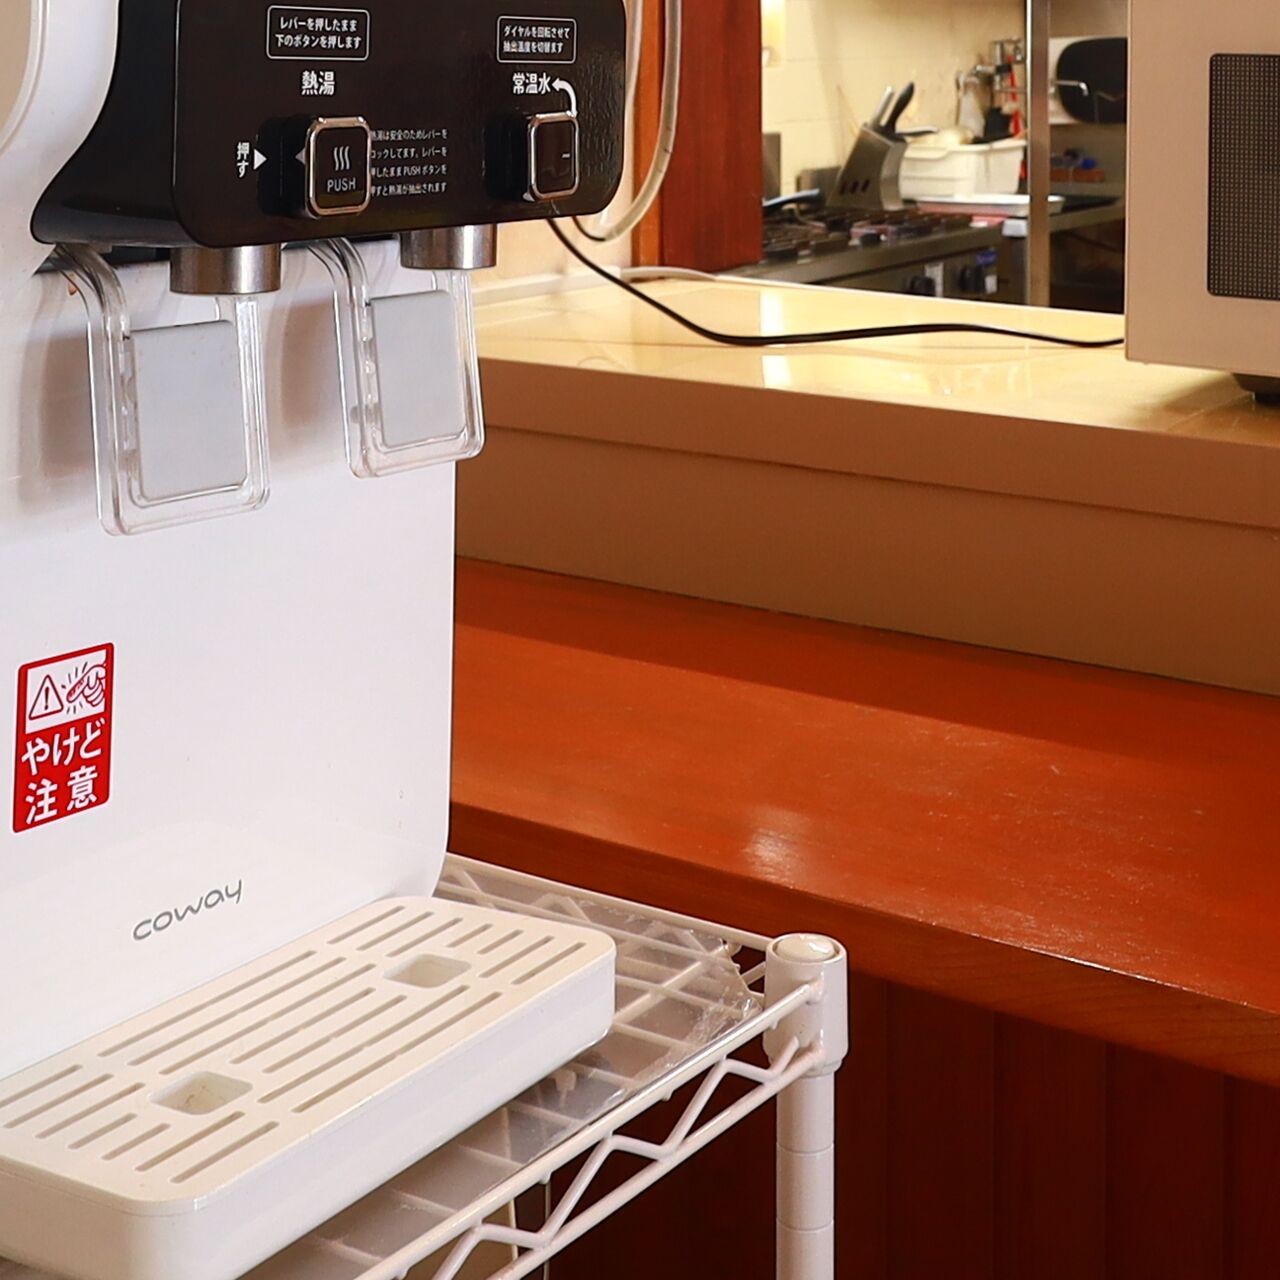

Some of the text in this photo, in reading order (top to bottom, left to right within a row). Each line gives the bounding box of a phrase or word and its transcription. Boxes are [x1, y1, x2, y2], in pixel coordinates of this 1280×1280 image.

[280, 16, 358, 33] レバーを押したまま
[503, 24, 570, 40] ダイヤルを回転させて
[275, 33, 362, 50] 下のボタンを押します
[301, 70, 336, 96] 熱湯
[512, 72, 551, 95] 常温水
[236, 141, 250, 179] 押す
[326, 178, 357, 193] PUSH
[21, 717, 106, 777] やけど
[25, 764, 99, 825] 注意
[132, 878, 243, 942] coway
